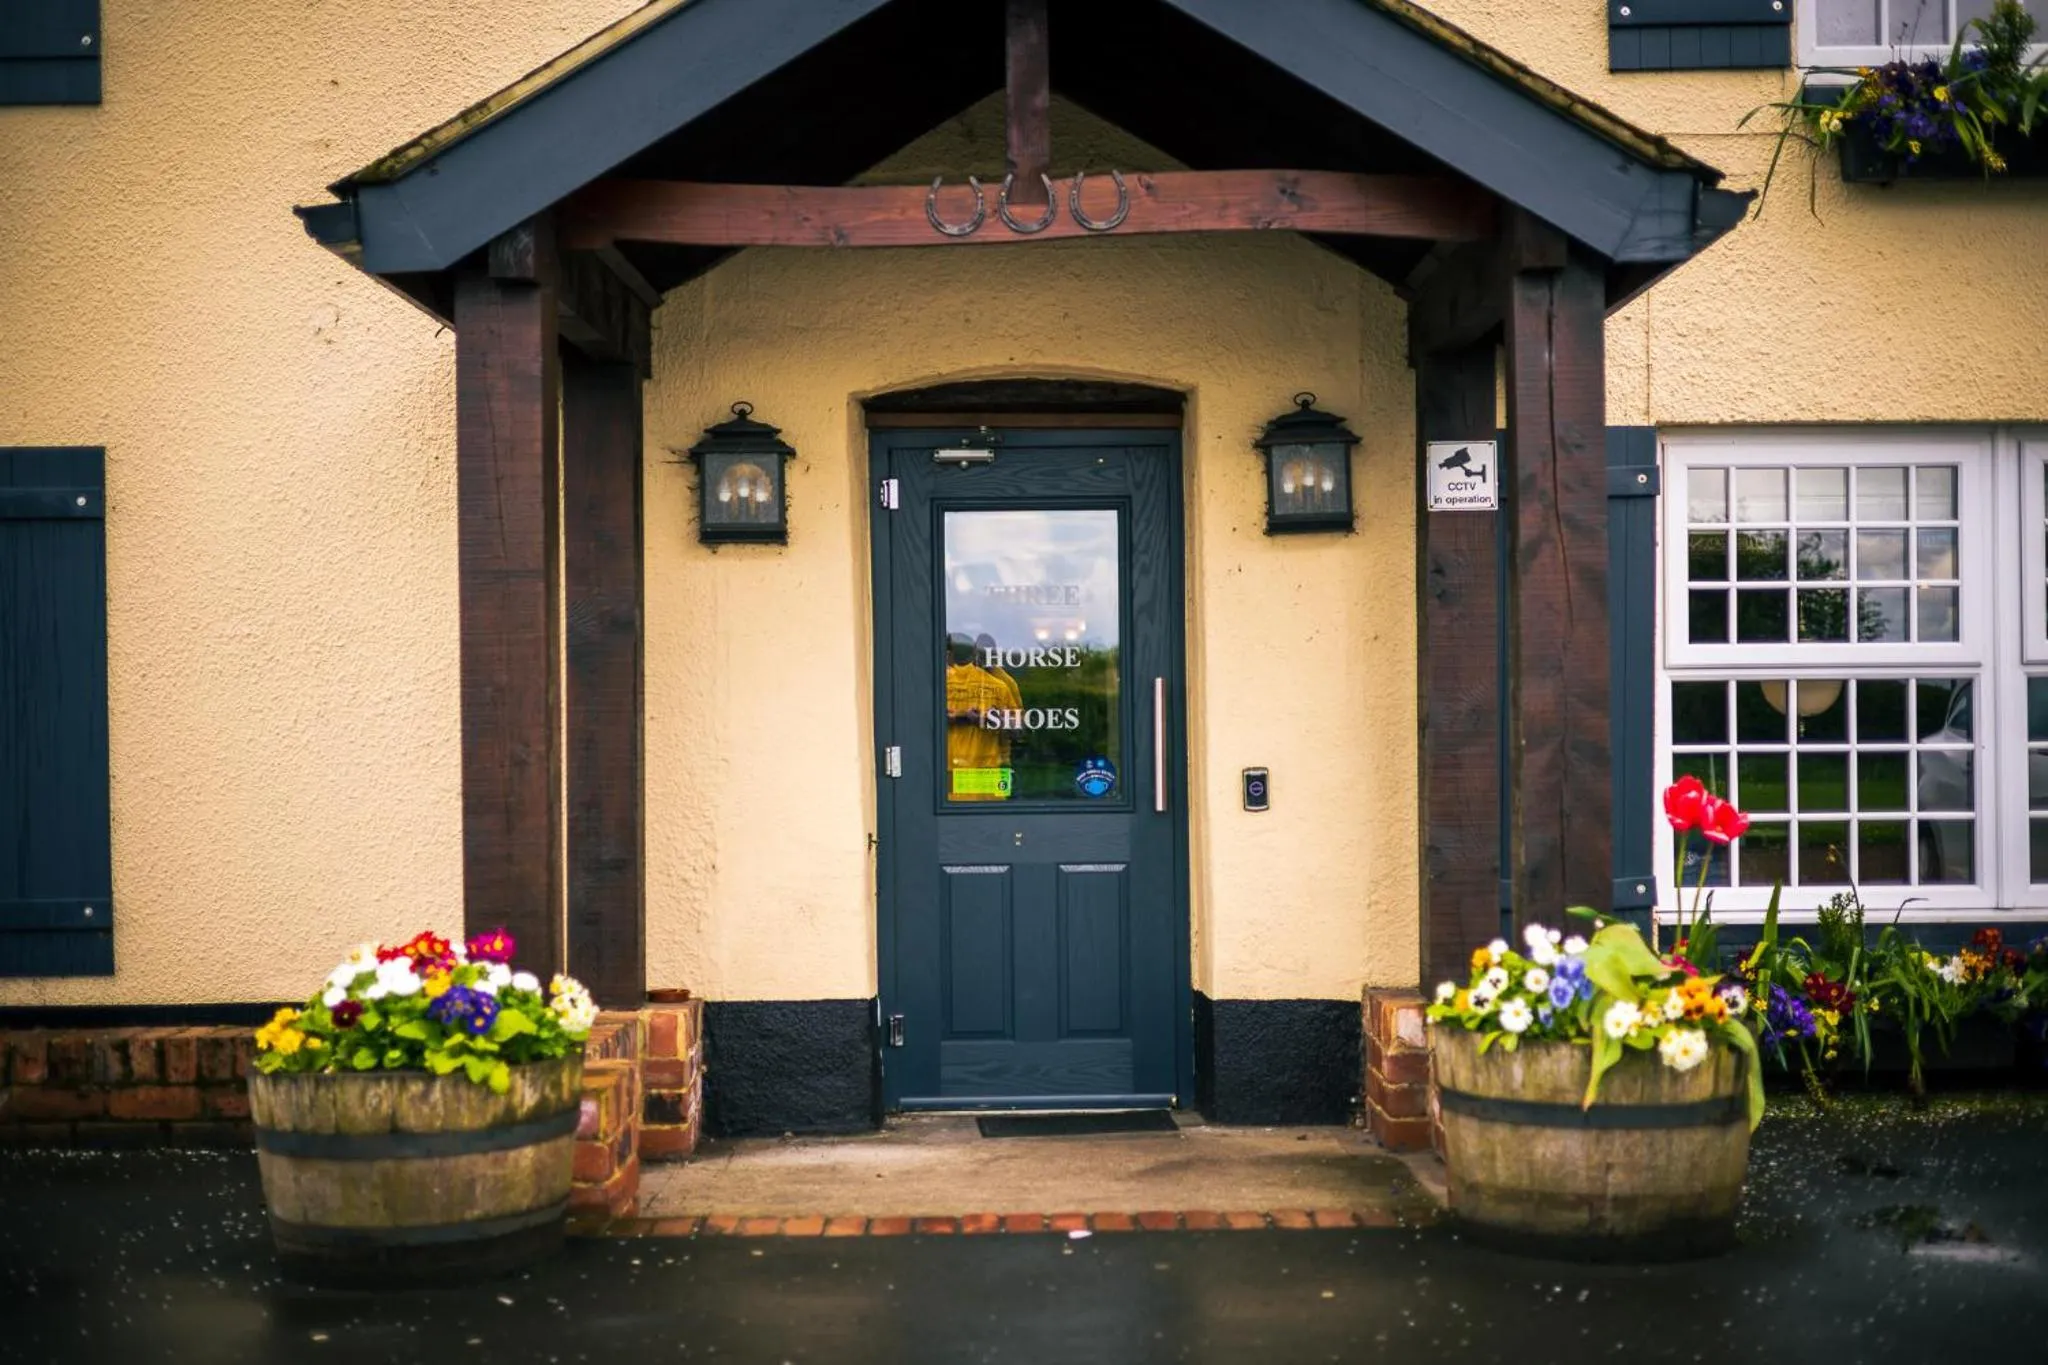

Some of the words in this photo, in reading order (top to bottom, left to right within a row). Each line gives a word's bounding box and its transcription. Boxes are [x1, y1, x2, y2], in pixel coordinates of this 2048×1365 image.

[1448, 482, 1477, 491] CCTV
[1434, 495, 1442, 504] in
[1445, 495, 1492, 505] operation
[985, 647, 1081, 668] HORSE
[986, 708, 1080, 730] SHOES
